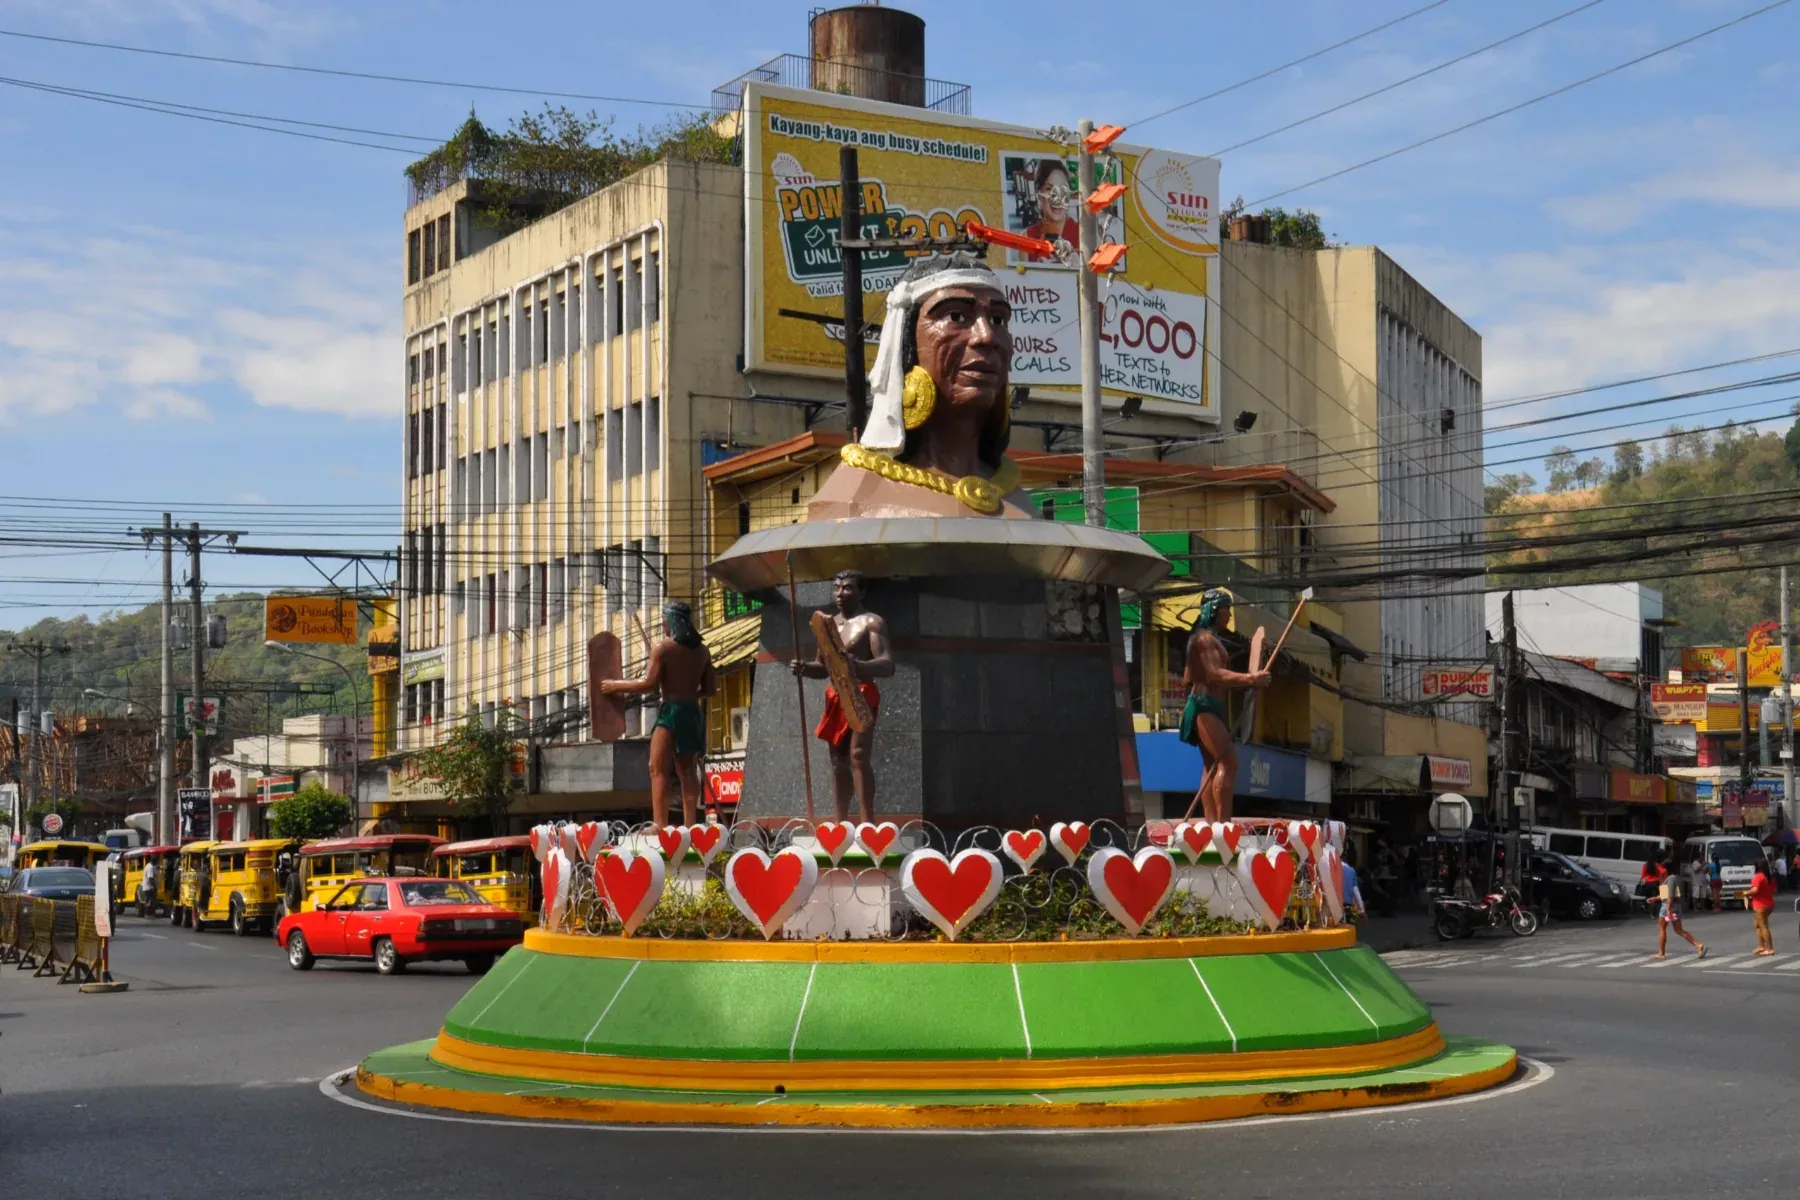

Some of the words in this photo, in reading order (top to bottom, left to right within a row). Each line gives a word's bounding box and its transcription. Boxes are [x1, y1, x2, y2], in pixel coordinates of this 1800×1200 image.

[771, 116, 858, 143] Kayang-kaya
[861, 133, 885, 147] ang
[889, 134, 920, 152] busy
[923, 140, 985, 161] schedule!
[779, 183, 885, 222] POWR
[827, 224, 880, 246] TXT
[808, 284, 834, 296] Valid
[1005, 286, 1060, 304] IMITED
[1119, 294, 1140, 305] now
[1143, 296, 1167, 310] with
[1012, 308, 1061, 324] TEXTS
[1013, 337, 1058, 354] OURS
[1015, 356, 1071, 372] CALLS
[1114, 352, 1157, 373] TEXTS
[1160, 360, 1170, 376] to
[1132, 375, 1200, 399] NETWORKS
[1674, 703, 1705, 711] MANSION
